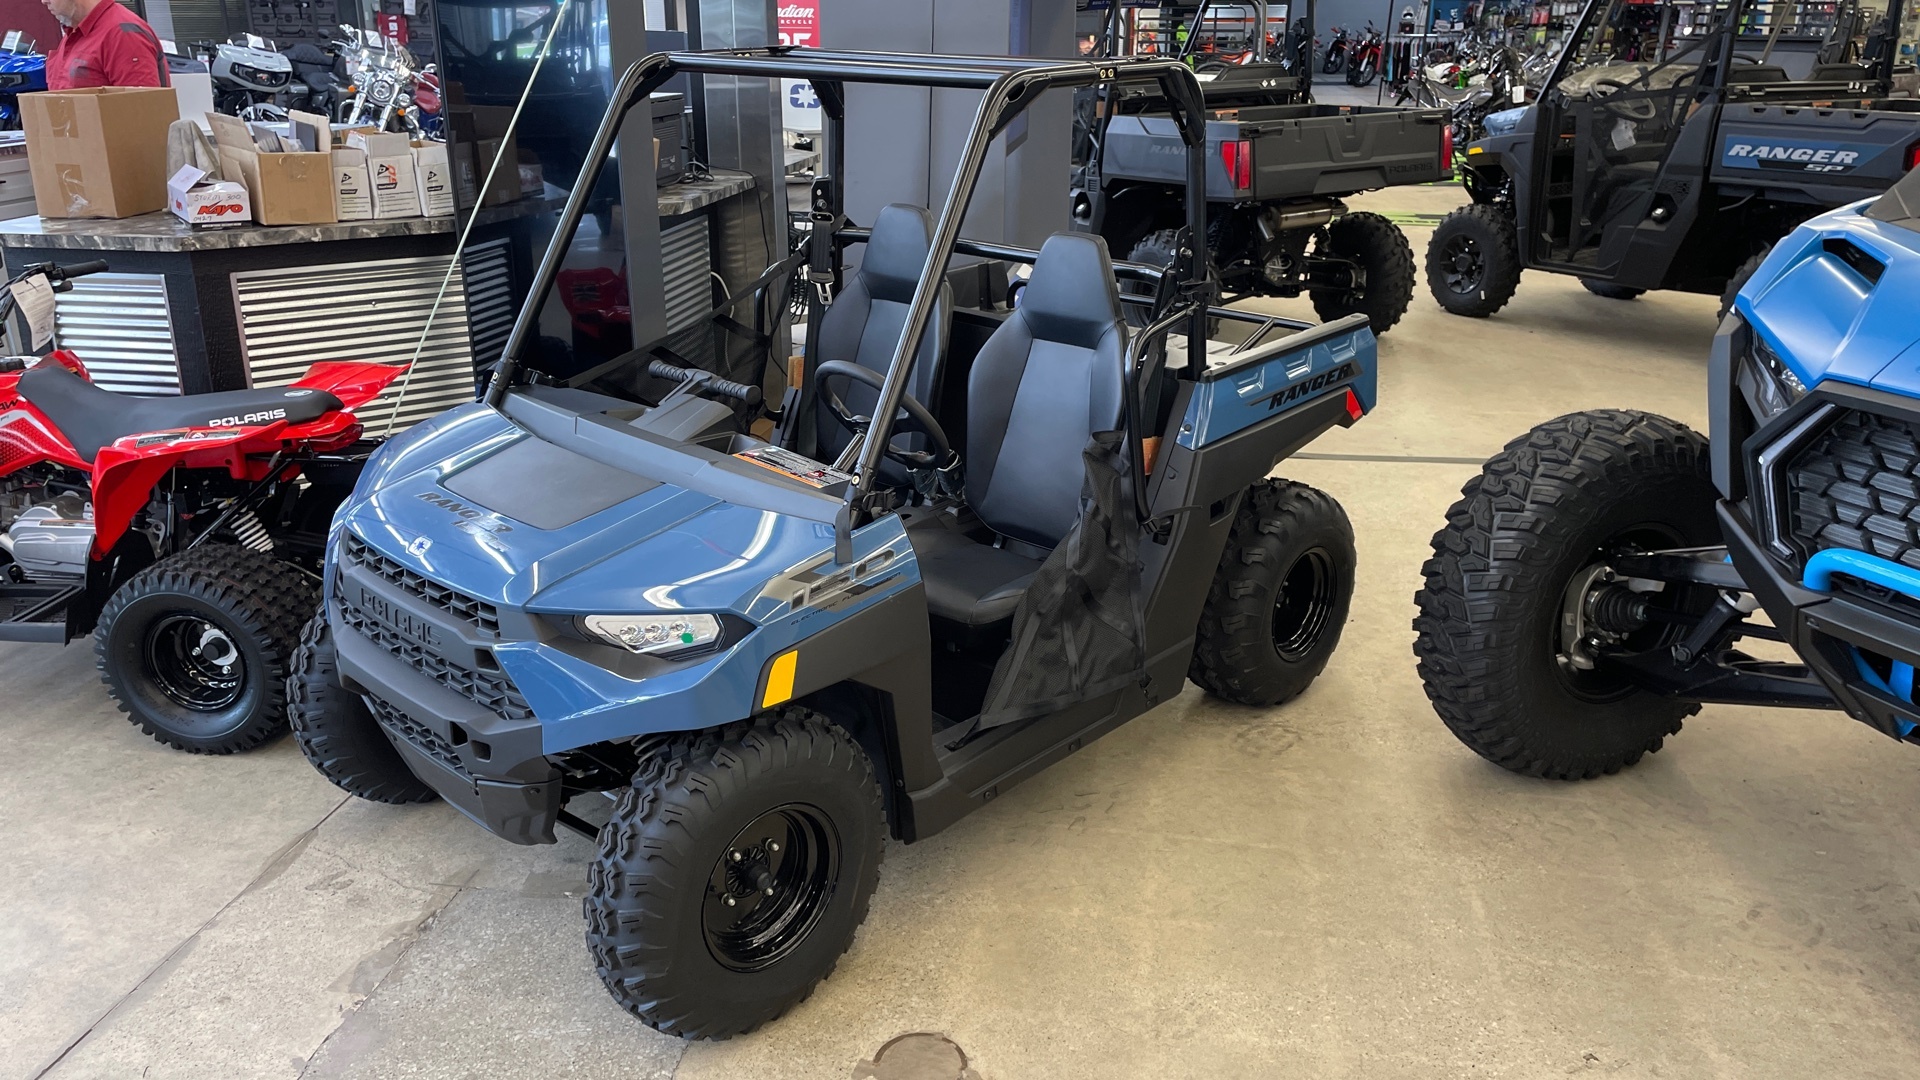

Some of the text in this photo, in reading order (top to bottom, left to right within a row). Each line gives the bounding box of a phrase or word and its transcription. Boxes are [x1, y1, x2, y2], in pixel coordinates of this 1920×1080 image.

[778, 4, 814, 18] ndian
[1150, 141, 1215, 158] RANR
[1728, 144, 1859, 164] RANGER
[1804, 164, 1844, 172] SP
[197, 200, 244, 216] KAYO
[1268, 363, 1355, 411] RANGER
[208, 408, 287, 428] POLARIS
[414, 492, 515, 534] RANGR
[360, 586, 442, 653] POLARIS
